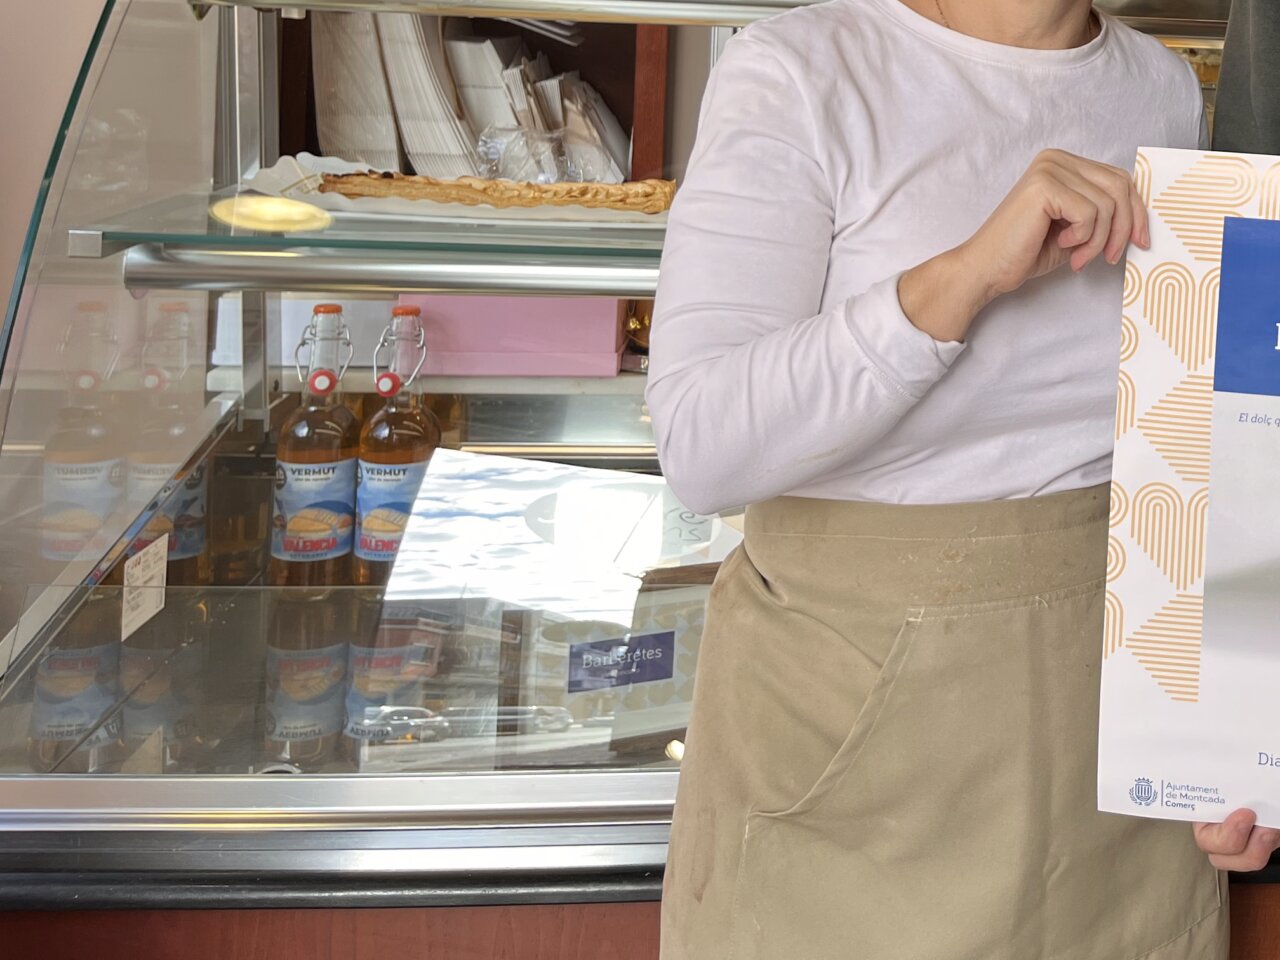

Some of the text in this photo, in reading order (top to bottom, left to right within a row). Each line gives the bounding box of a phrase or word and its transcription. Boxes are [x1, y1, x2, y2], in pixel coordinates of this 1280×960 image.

[1239, 413, 1249, 422] El
[1251, 414, 1272, 427] dolç
[290, 466, 338, 476] VERMUT
[364, 466, 409, 477] VERMUT
[582, 648, 663, 669] Barberetes
[1166, 782, 1218, 795] Ajuntament
[1166, 792, 1225, 804] de Montcada
[1165, 800, 1196, 811] Comerç
